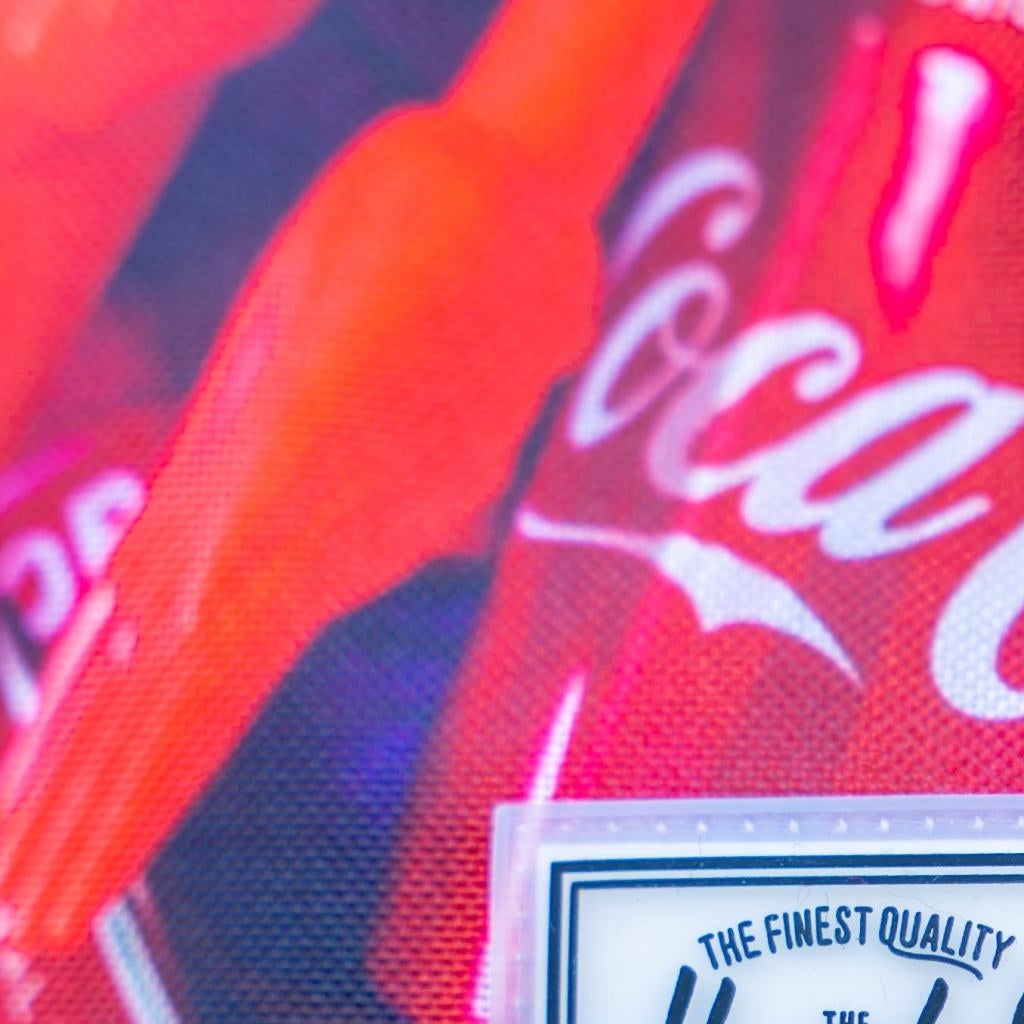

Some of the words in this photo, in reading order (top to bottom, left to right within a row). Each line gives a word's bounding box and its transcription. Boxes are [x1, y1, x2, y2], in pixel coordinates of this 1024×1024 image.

[697, 920, 762, 970] THE
[764, 905, 873, 955] FINEST
[878, 906, 1016, 981] QUALITY
